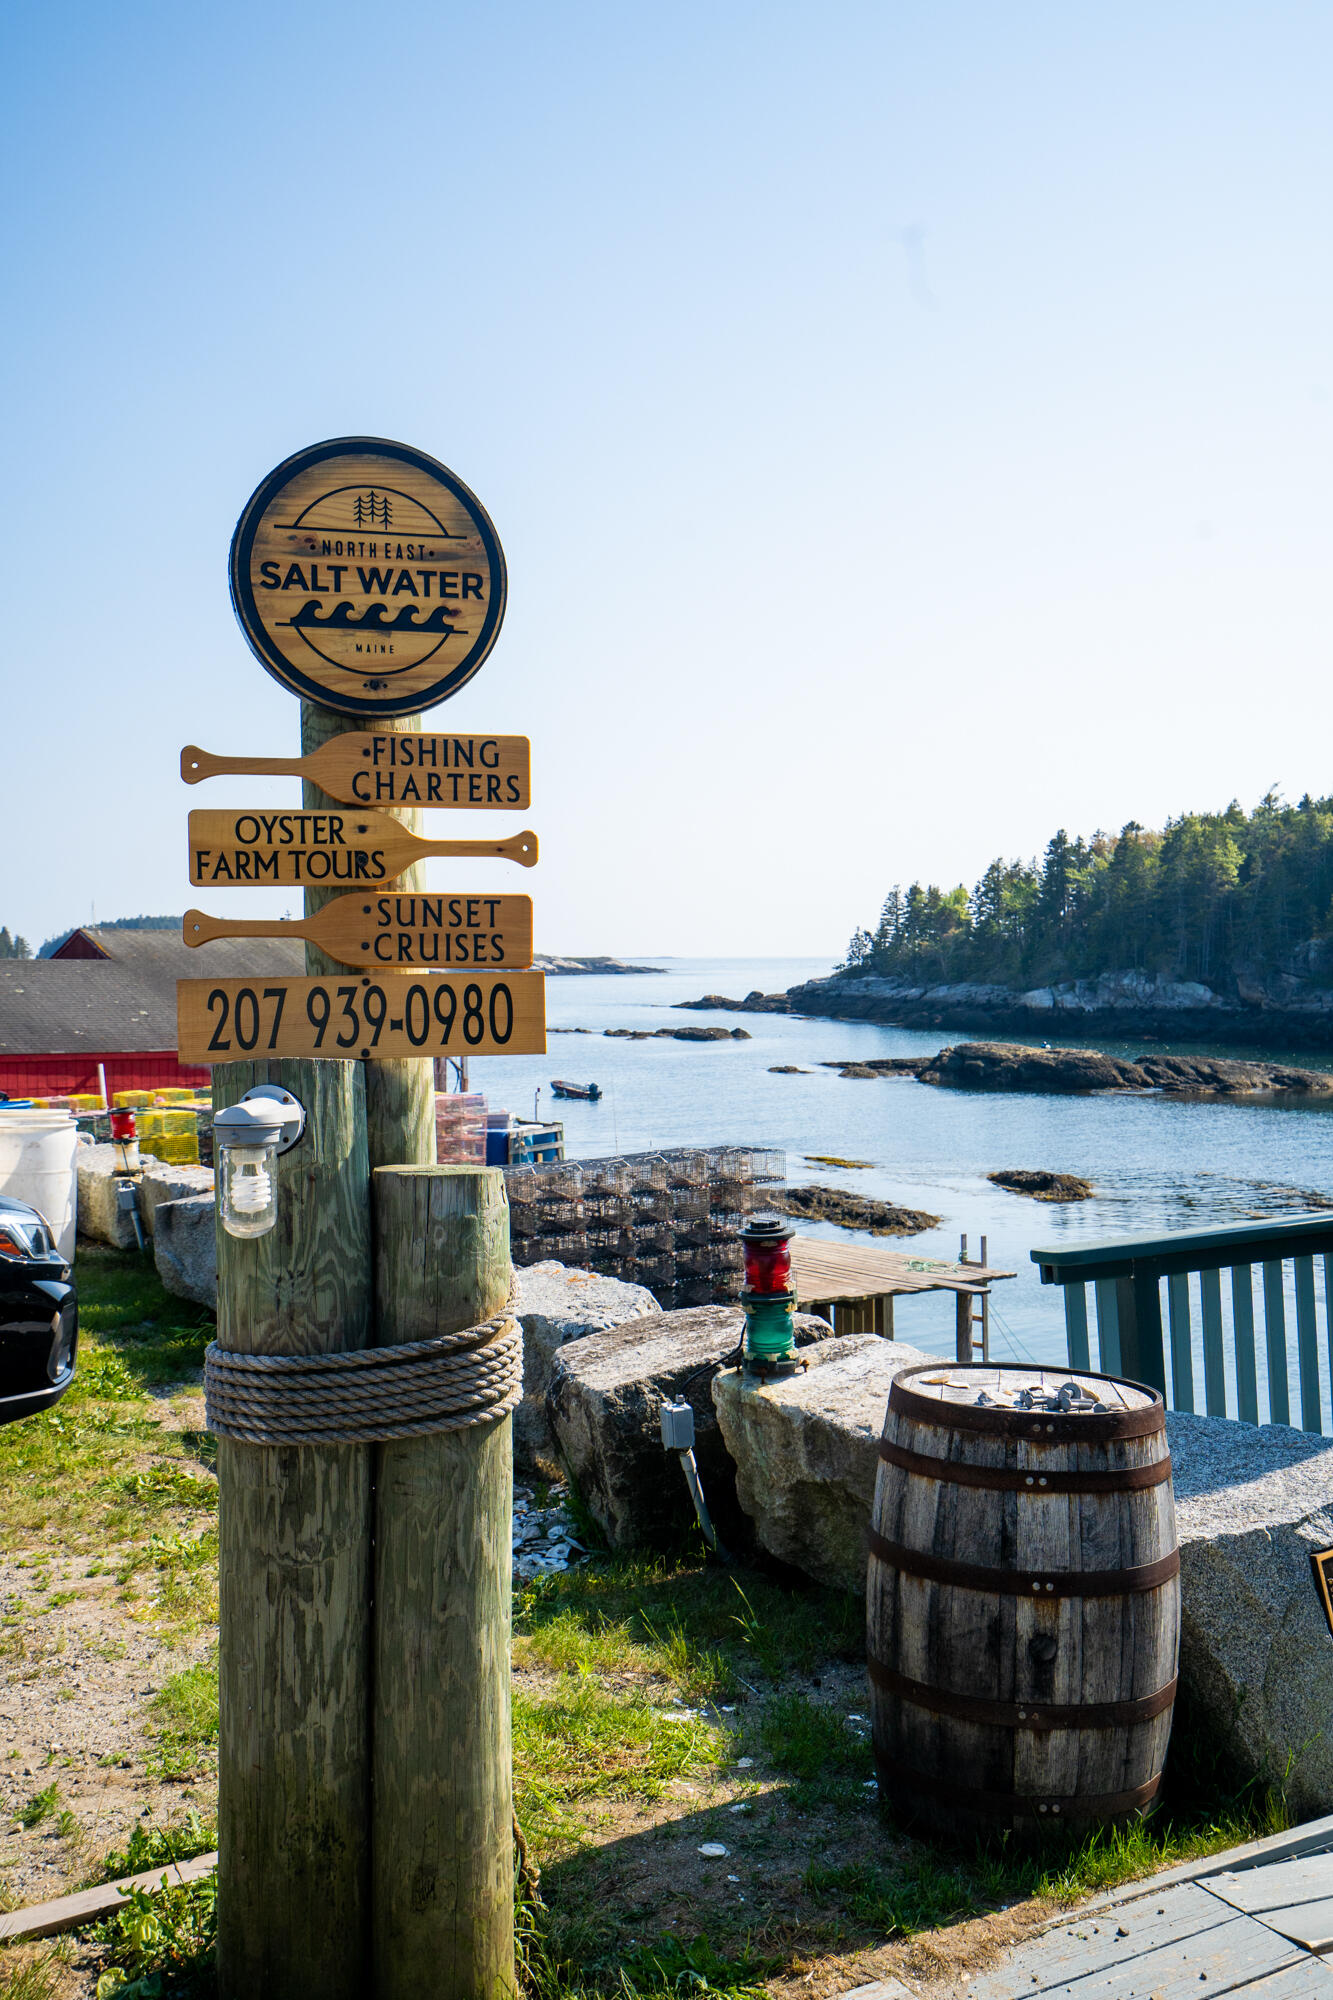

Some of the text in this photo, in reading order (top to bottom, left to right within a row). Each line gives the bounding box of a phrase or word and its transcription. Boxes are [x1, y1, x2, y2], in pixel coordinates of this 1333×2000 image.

[322, 540, 425, 561] NORTH EAST
[259, 561, 485, 600] SALT WATER
[355, 644, 395, 654] MAINE
[372, 737, 500, 768] FISHING
[352, 771, 521, 803] CHARTERS
[235, 815, 346, 845] OYSTER
[196, 850, 386, 880] FARM TOURS
[377, 899, 502, 928] SUNSET
[373, 933, 505, 962] CRUISES
[207, 983, 514, 1051] 207 939-0980
